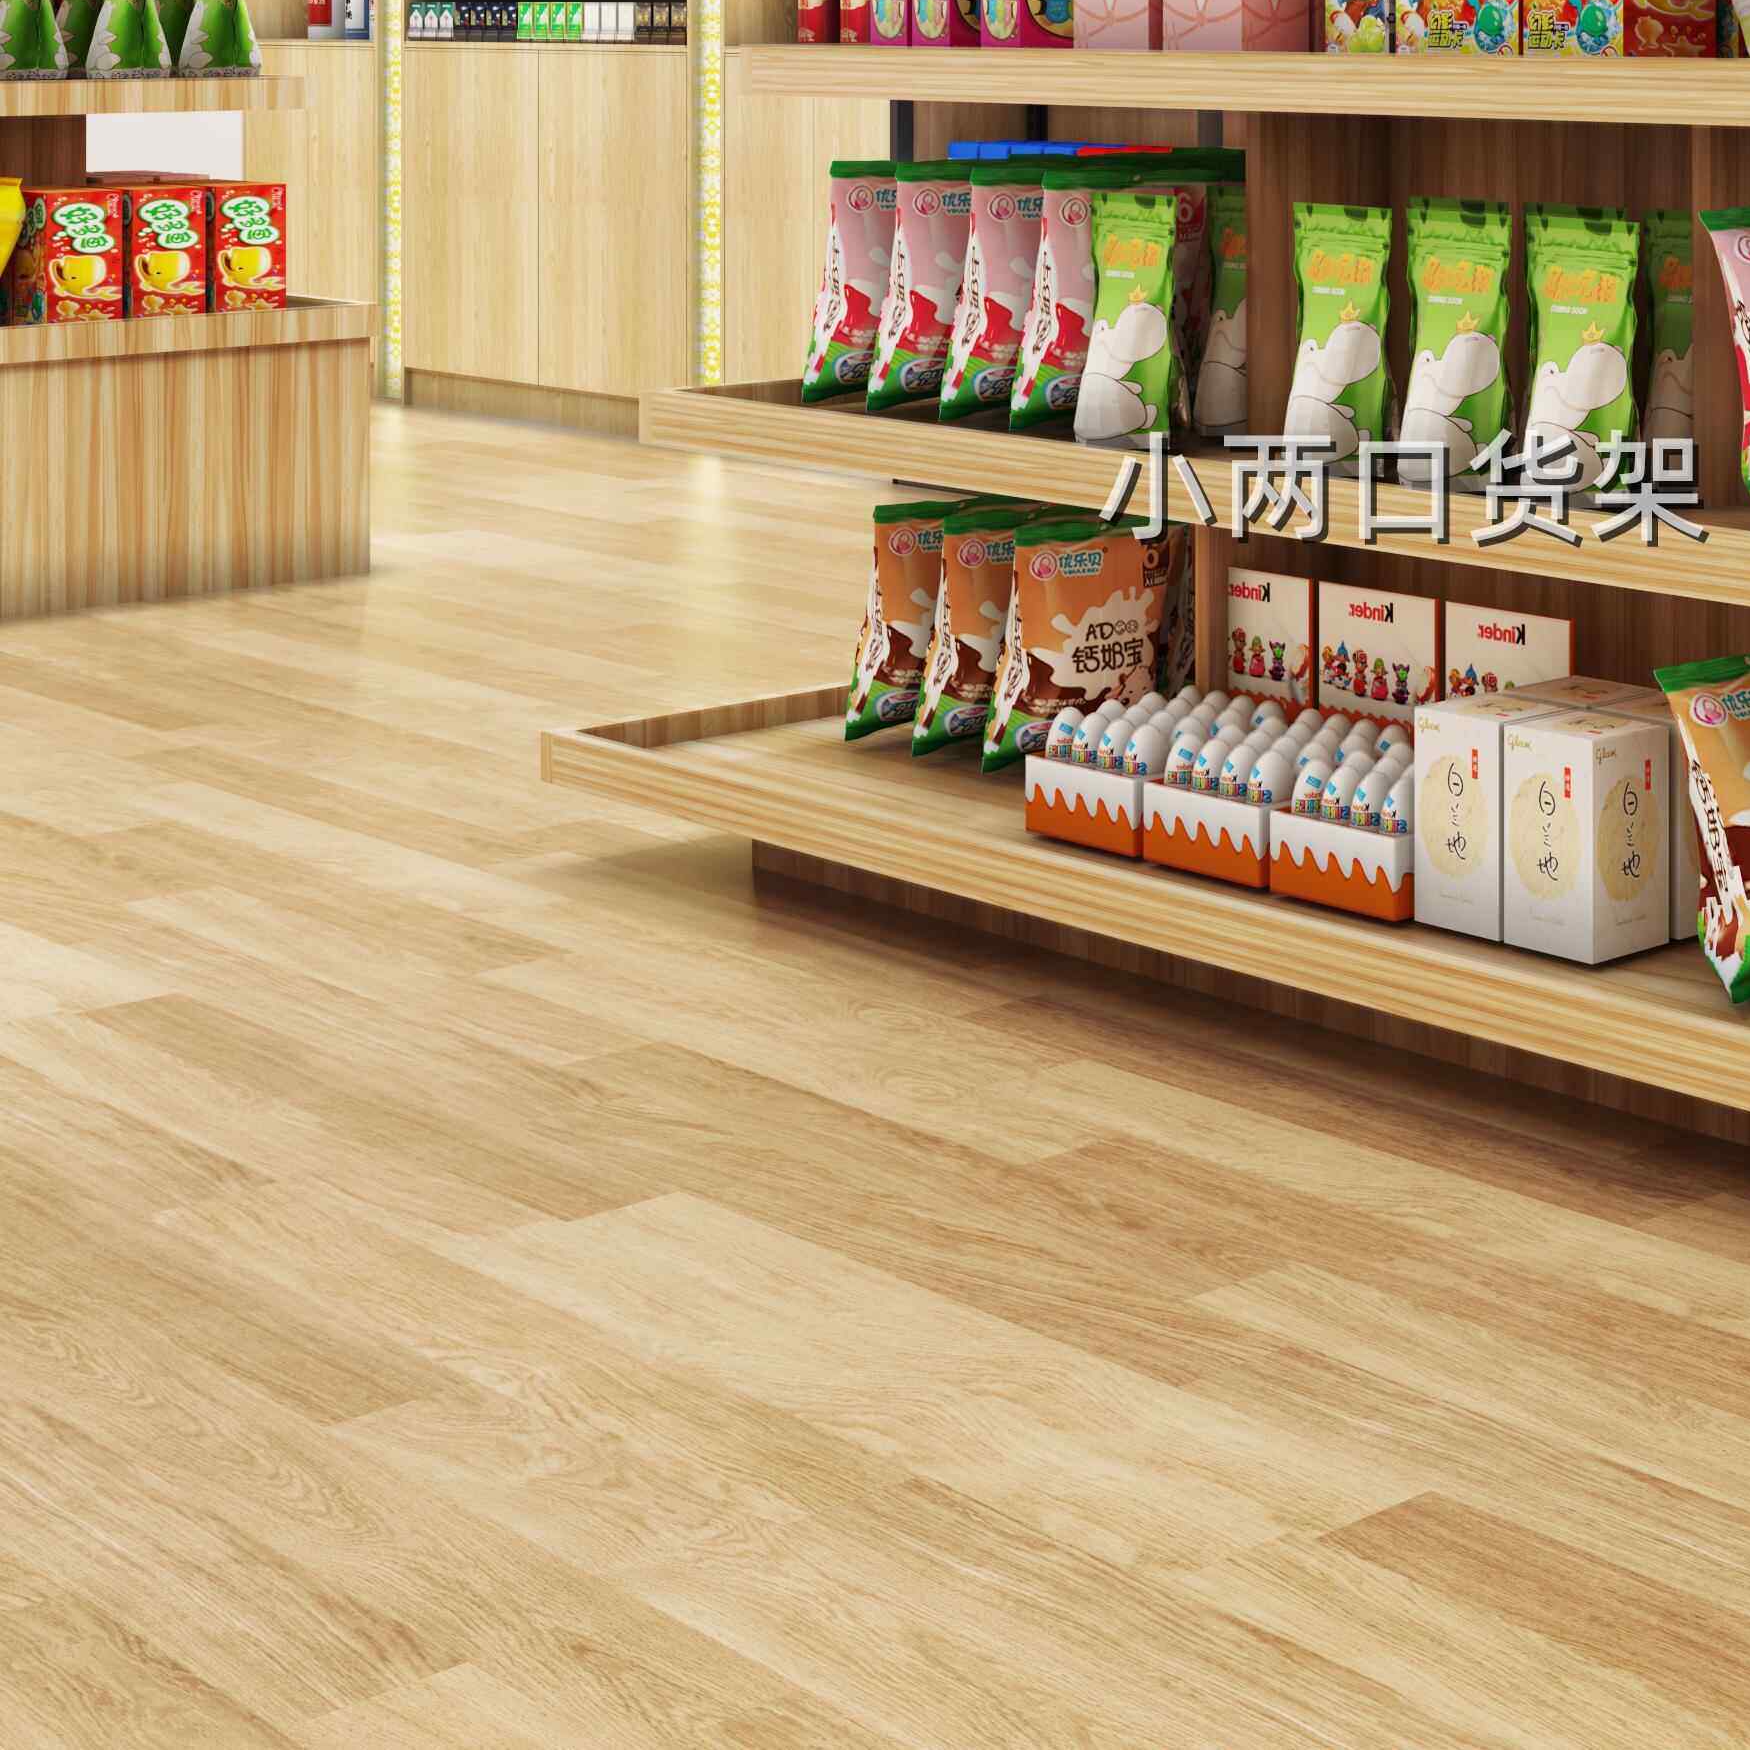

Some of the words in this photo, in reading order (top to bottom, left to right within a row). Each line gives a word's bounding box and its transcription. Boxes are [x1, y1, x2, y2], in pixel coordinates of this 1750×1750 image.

[1057, 552, 1102, 569] 优乐贝
[1071, 637, 1145, 674] 钙奶宝
